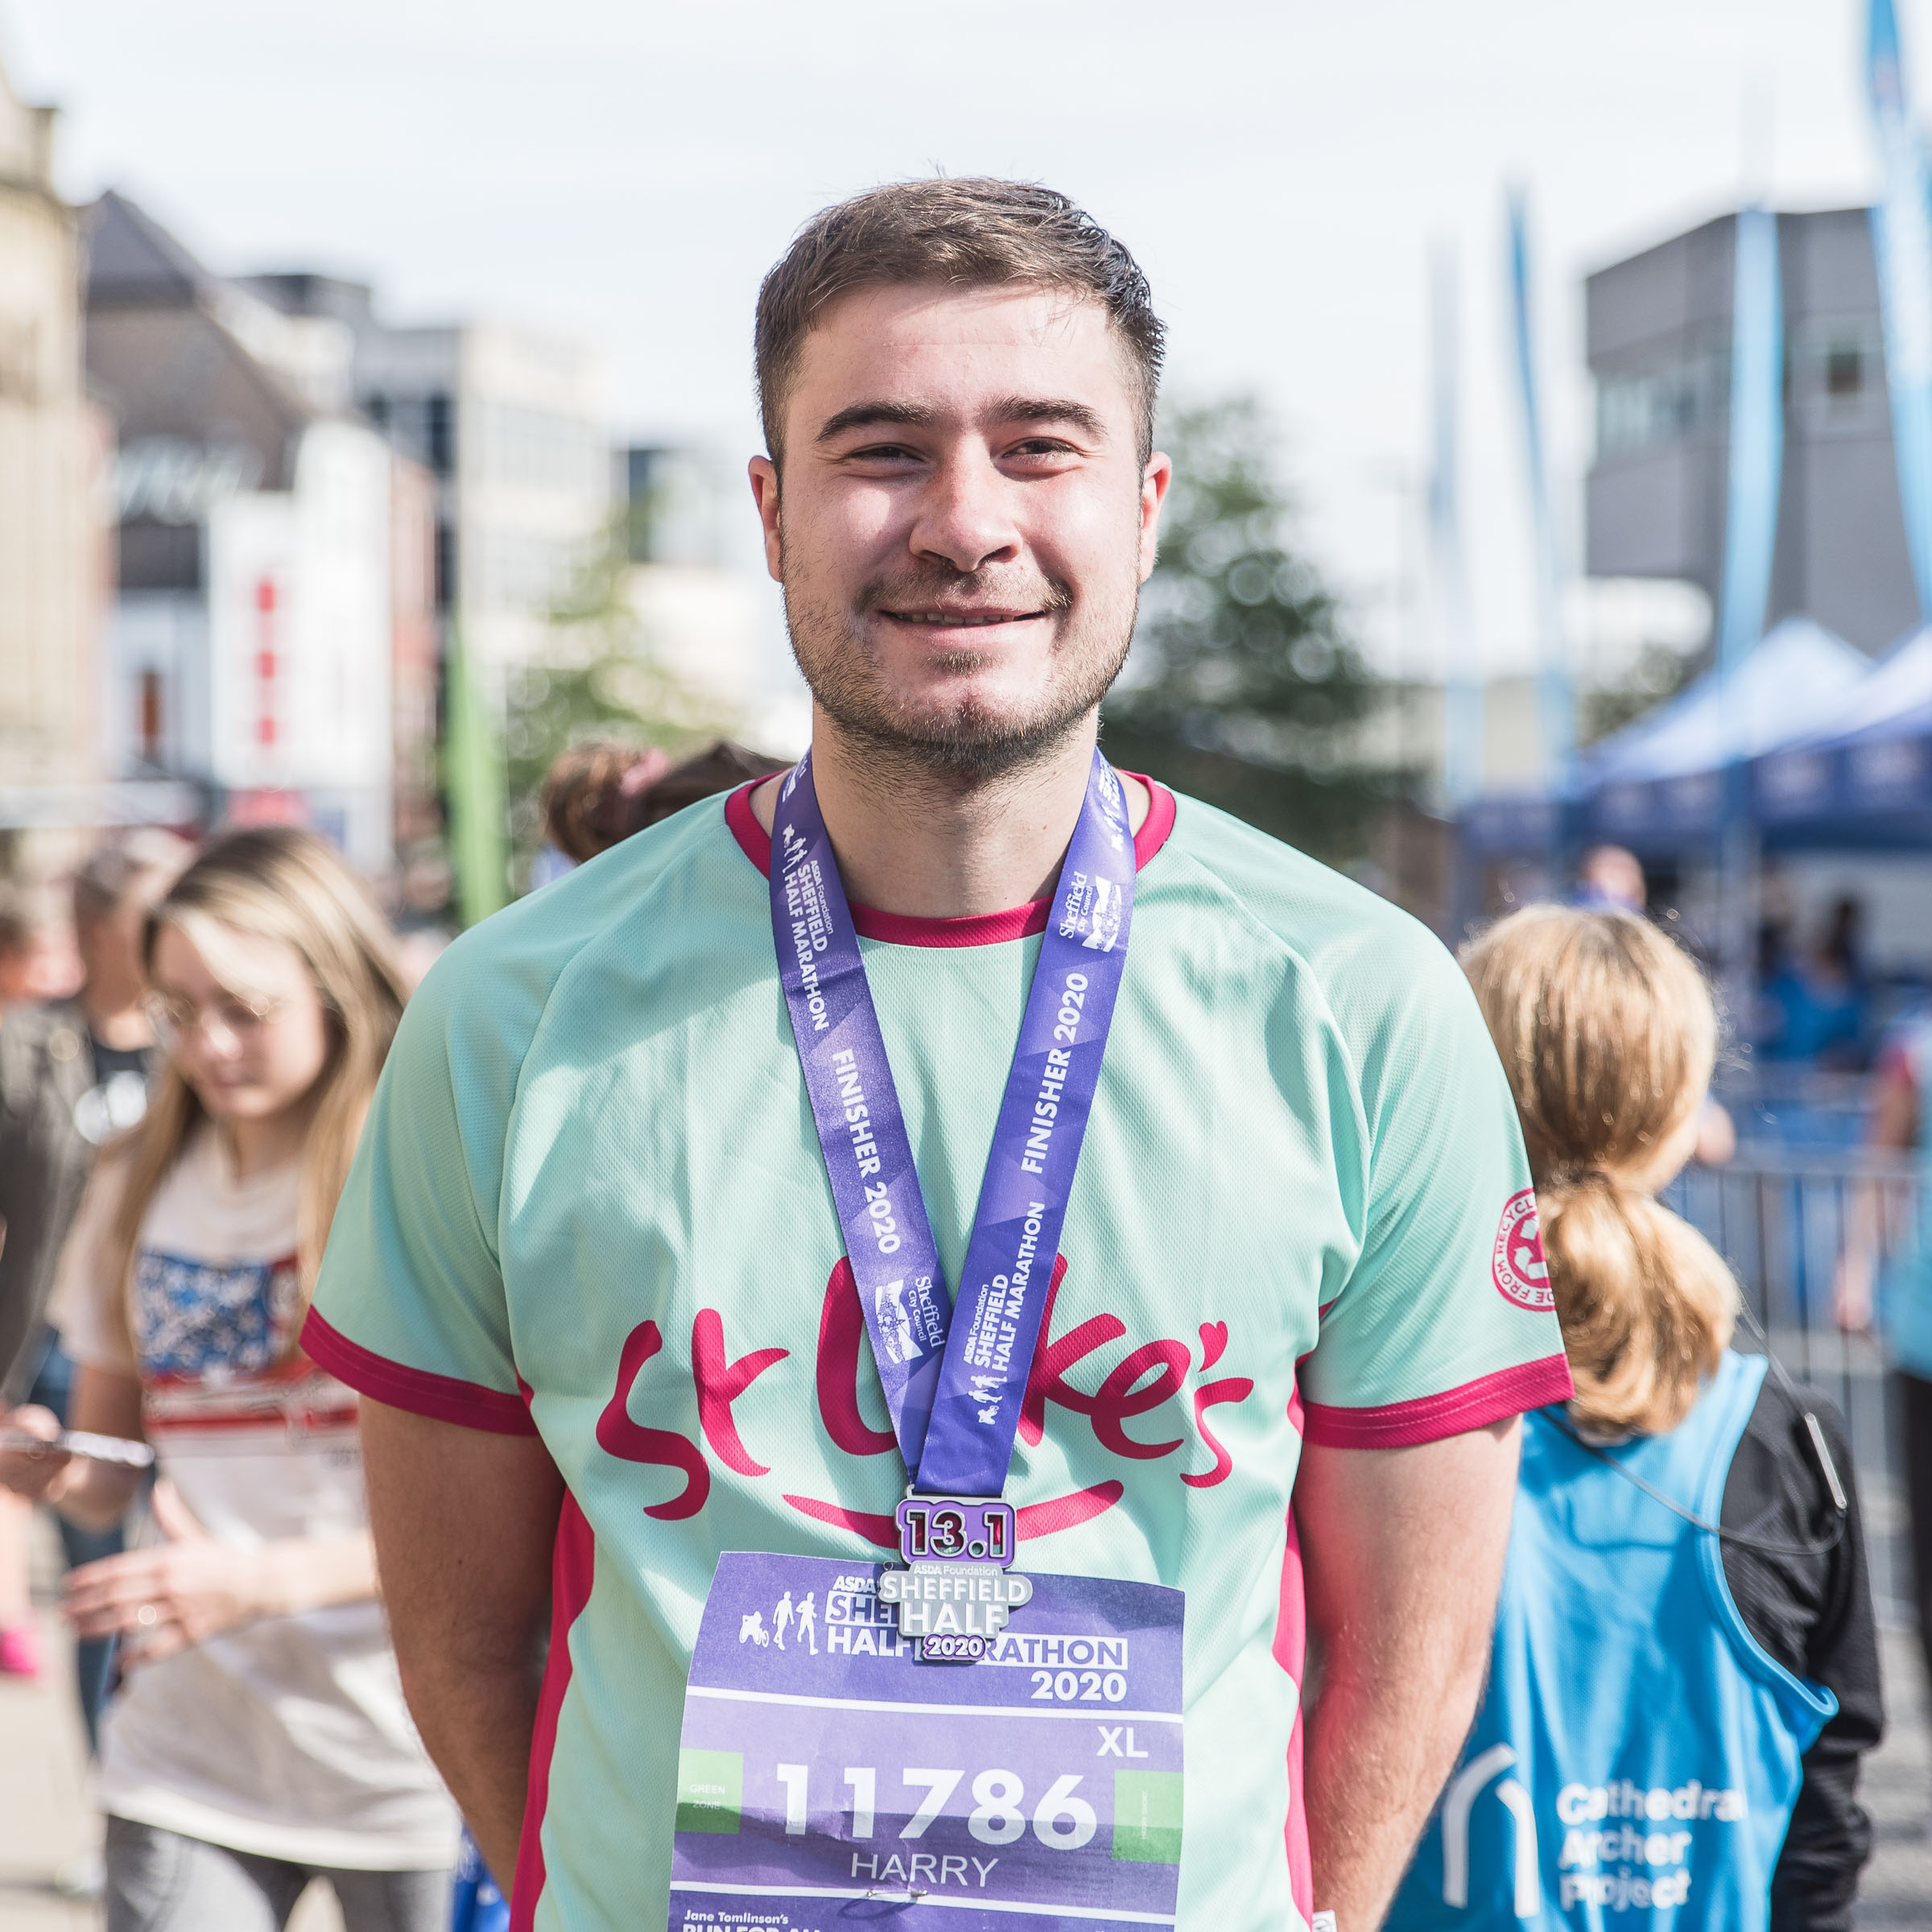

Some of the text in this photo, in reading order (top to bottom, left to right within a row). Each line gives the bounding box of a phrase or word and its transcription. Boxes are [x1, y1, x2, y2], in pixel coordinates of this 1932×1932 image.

[797, 864, 828, 952] SHEFFIELD
[810, 859, 834, 935] ASDA Foundation
[1059, 870, 1088, 939] Sheffield
[1080, 885, 1094, 916] Council
[784, 871, 830, 1032] HALF MARATHON
[1020, 972, 1089, 1174] FINISHER 2020
[832, 1048, 902, 1255] FINISHER 2020
[1496, 1198, 1534, 1255] RECYCL
[991, 1200, 1046, 1373] HALF MARATHON
[1496, 1259, 1530, 1300] FROM
[908, 1290, 927, 1342] City Council
[914, 1275, 947, 1348] Sheffield
[963, 1283, 989, 1364] ASDA Foundation
[973, 1274, 1009, 1368] SHEFFIELD
[596, 1252, 1254, 1521] St Lke's
[906, 1508, 1008, 1559] 13.1
[832, 1575, 877, 1594] ASDA
[882, 1575, 1026, 1603] SHEFFIELD
[913, 1564, 999, 1577] ASDA Foundation
[903, 1600, 1005, 1635] HALF
[927, 1636, 982, 1657] 2020
[1030, 1670, 1127, 1703] 2020
[1096, 1726, 1149, 1758] XL
[689, 1783, 726, 1795] GREEN
[692, 1800, 722, 1810] ZONE
[777, 1763, 1097, 1851] 11786
[850, 1852, 999, 1888] HARRY
[1557, 1822, 1692, 1870] Archer
[683, 1909, 789, 1926] Jane Tomlinson's
